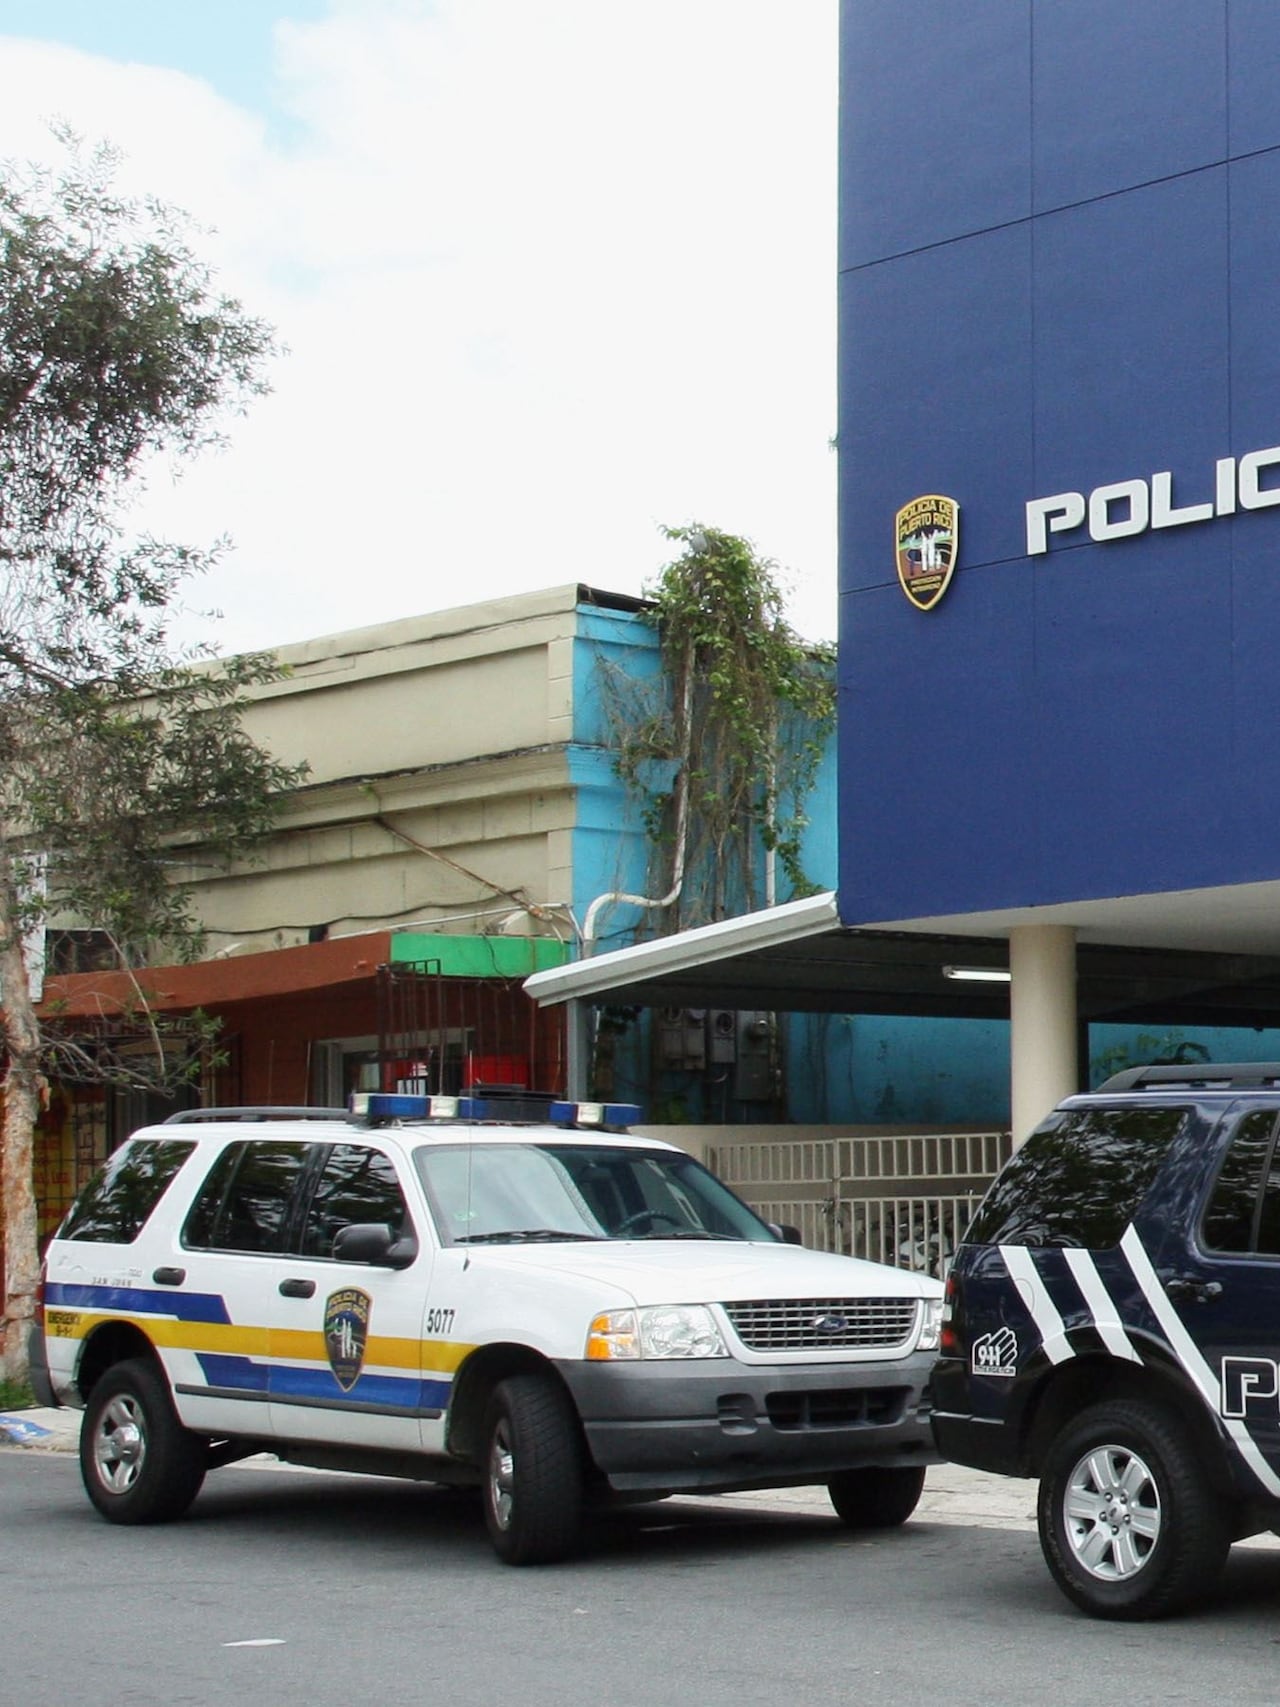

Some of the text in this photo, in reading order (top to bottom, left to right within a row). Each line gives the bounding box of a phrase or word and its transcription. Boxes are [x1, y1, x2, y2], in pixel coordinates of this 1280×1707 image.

[900, 500, 953, 526] POLICIA DE
[900, 512, 953, 541] PUERTO RICO
[426, 1308, 455, 1334] 5077
